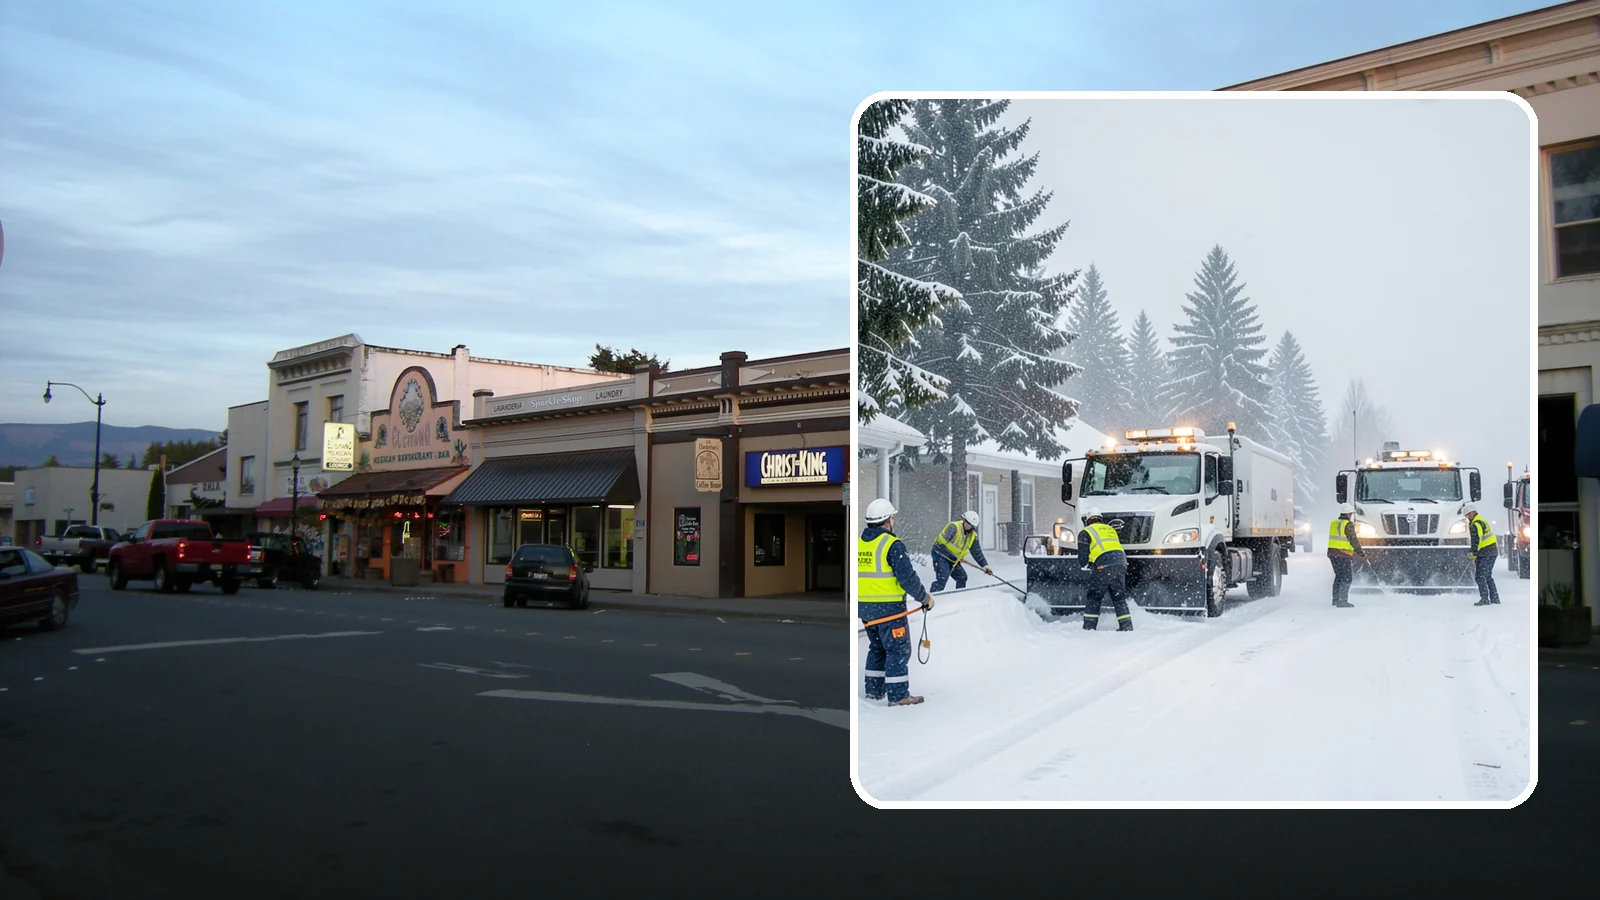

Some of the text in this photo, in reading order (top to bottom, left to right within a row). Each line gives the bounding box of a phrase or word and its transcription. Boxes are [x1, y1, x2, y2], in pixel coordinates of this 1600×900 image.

[595, 389, 623, 400] LAUNDRY
[530, 394, 583, 409] Sparkle Shop
[493, 402, 522, 413] LAVANDERIA
[397, 451, 433, 461] RESTAURANT
[437, 450, 450, 459] BAR
[761, 450, 827, 477] CHRIST KING
